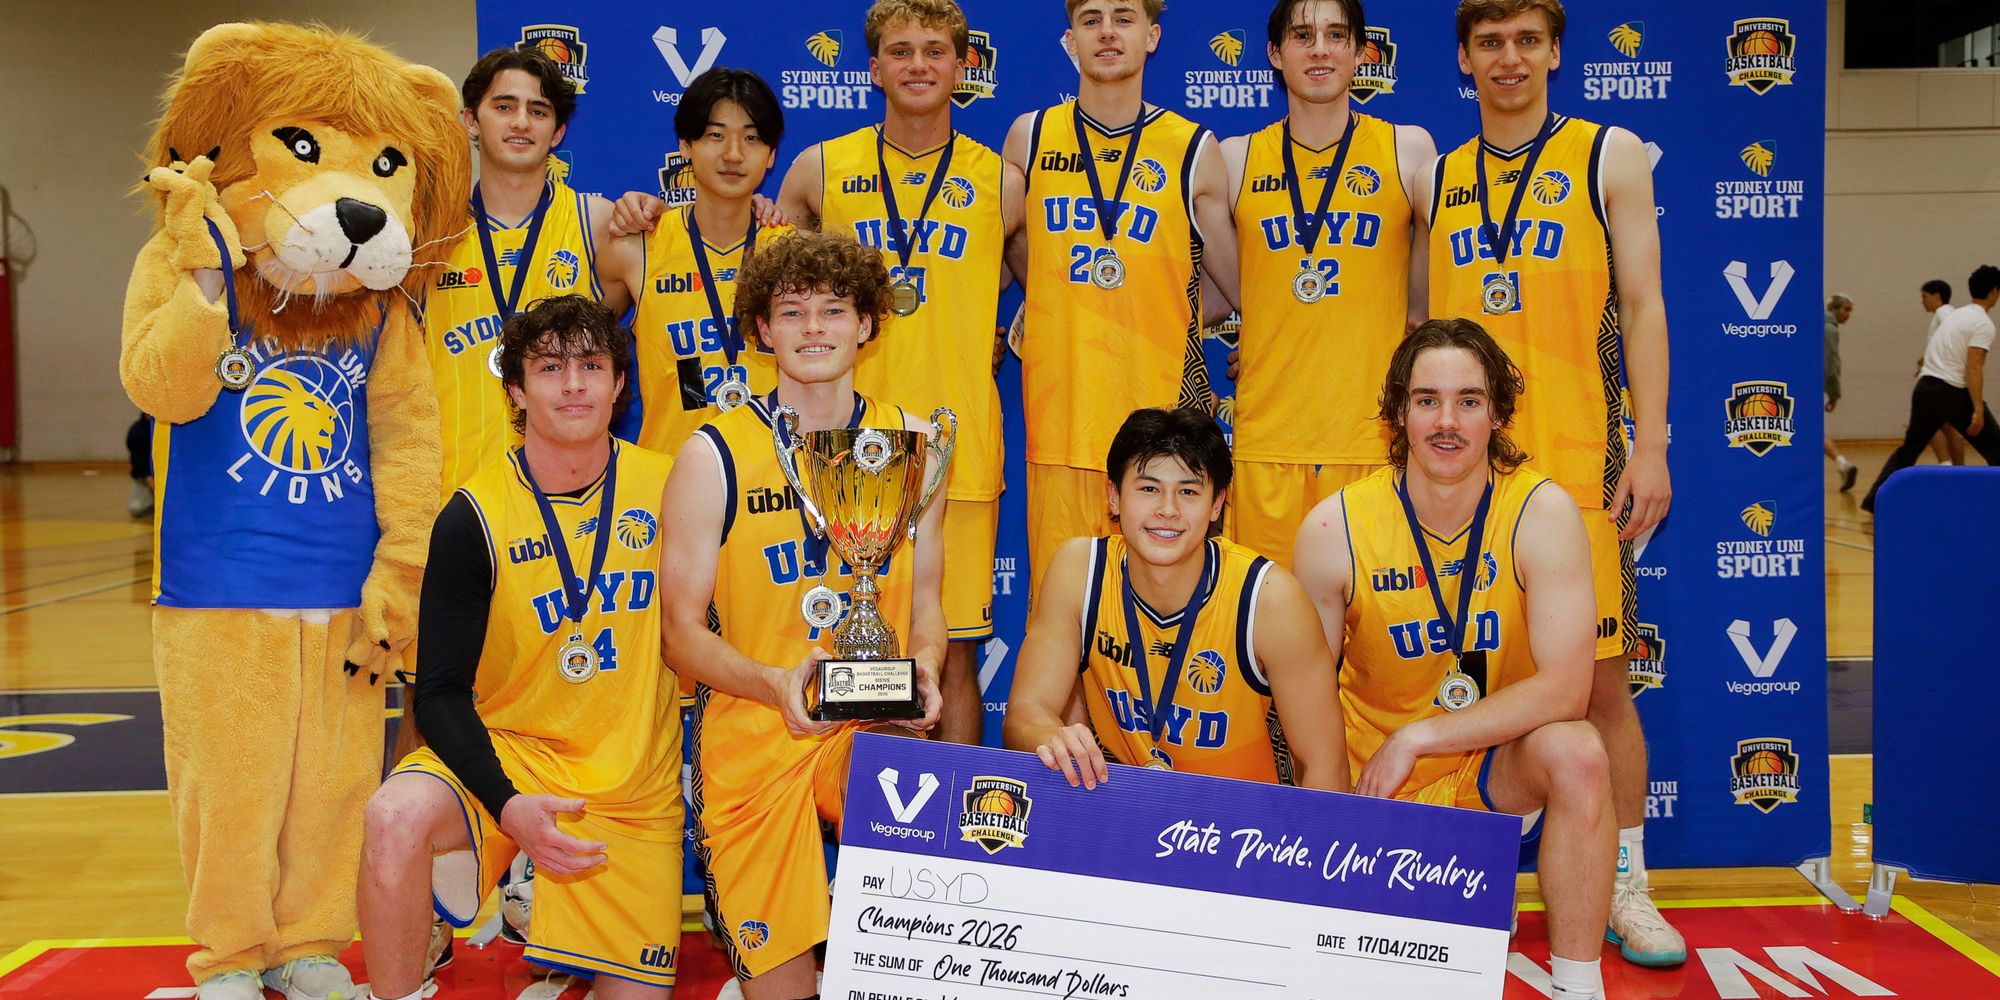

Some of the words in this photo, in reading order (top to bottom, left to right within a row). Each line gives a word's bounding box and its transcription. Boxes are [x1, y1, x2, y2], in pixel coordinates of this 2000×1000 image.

[527, 30, 574, 40] UNIVERSITY
[1738, 23, 1784, 33] UNIVERSITY
[1584, 62, 1640, 76] SYDNEY
[1644, 61, 1672, 74] UNI
[1726, 54, 1796, 72] BASKETBALL
[781, 70, 840, 85] SYDNEY
[844, 71, 872, 85] UNI
[1185, 70, 1242, 84] SYDNEY
[1246, 70, 1274, 84] UNI
[1738, 69, 1783, 80] CHALLENGE
[1584, 75, 1672, 100] SPORT
[782, 86, 872, 109] SPORT
[1185, 85, 1274, 108] SPORT
[1715, 180, 1772, 194] SYDNEY
[1776, 180, 1804, 193] UNI
[1716, 195, 1803, 218] SPORT
[1721, 323, 1797, 338] Vegagroup
[1737, 386, 1782, 396] UNIVERSITY
[1725, 416, 1795, 435] BASKETBALL
[1738, 432, 1782, 443] CHALLENGE
[226, 453, 363, 504] LIONS
[1716, 540, 1773, 555] SYDNEY
[1777, 539, 1804, 552] UNI
[1717, 554, 1804, 579] SPORT
[1387, 609, 1501, 660] USD
[858, 683, 907, 691] CHAMPIONS
[1726, 681, 1800, 695] Vegagroup
[1742, 743, 1787, 753] UNIVERSITY
[976, 780, 1022, 794] UNIVERSITY
[1650, 781, 1678, 794] UNI
[1731, 773, 1801, 791] BASKETBALL
[1744, 789, 1787, 799] CHALLENGE
[870, 820, 936, 843] Vegagroup
[959, 812, 1029, 836] BASKETBALL
[971, 828, 1016, 843] CHALLENGE
[1155, 819, 1221, 858] State
[1230, 828, 1313, 869] Pride.
[1322, 840, 1383, 882] Uni
[1387, 849, 1488, 900] Rivalry.
[862, 875, 885, 891] PAY
[889, 865, 989, 904] USYD
[857, 906, 955, 941] Champions
[958, 919, 1022, 950] 2026
[1316, 933, 1347, 950] DATE
[1356, 935, 1450, 964] 17/04/2026
[853, 951, 876, 967] THE
[878, 954, 907, 970] SUM
[908, 958, 924, 972] OF
[933, 954, 972, 980] One
[980, 958, 1063, 990] Thousand
[1063, 970, 1129, 1000] Dollars
